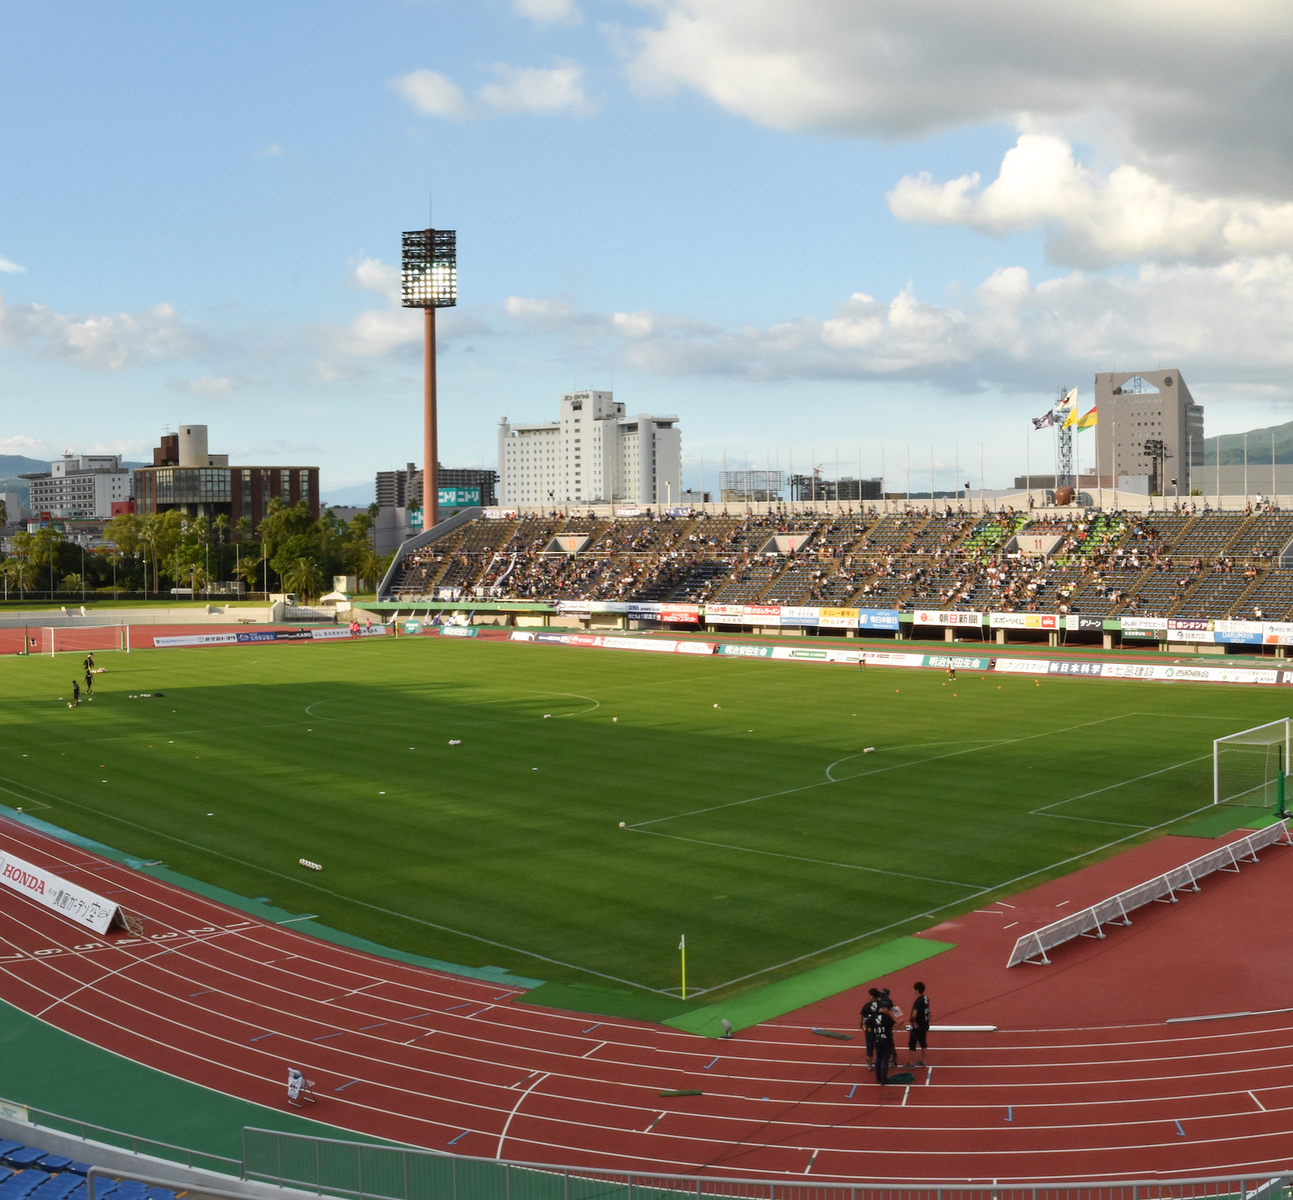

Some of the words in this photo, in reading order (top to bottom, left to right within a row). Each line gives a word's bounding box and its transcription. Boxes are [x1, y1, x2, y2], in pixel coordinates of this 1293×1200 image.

[439, 491, 456, 503] ニトリ
[458, 491, 479, 502] ニトリ
[1034, 538, 1042, 549] 11
[938, 613, 978, 624] 朝日新聞
[993, 616, 1024, 625] スポーツくじ
[1049, 662, 1101, 674] 新日本科学
[1116, 665, 1154, 677] 七呂建設
[2, 863, 46, 895] HONDA
[150, 932, 179, 940] 3
[187, 927, 216, 935] 2
[74, 943, 104, 951] 5
[114, 938, 142, 946] 4
[33, 948, 63, 956] 6
